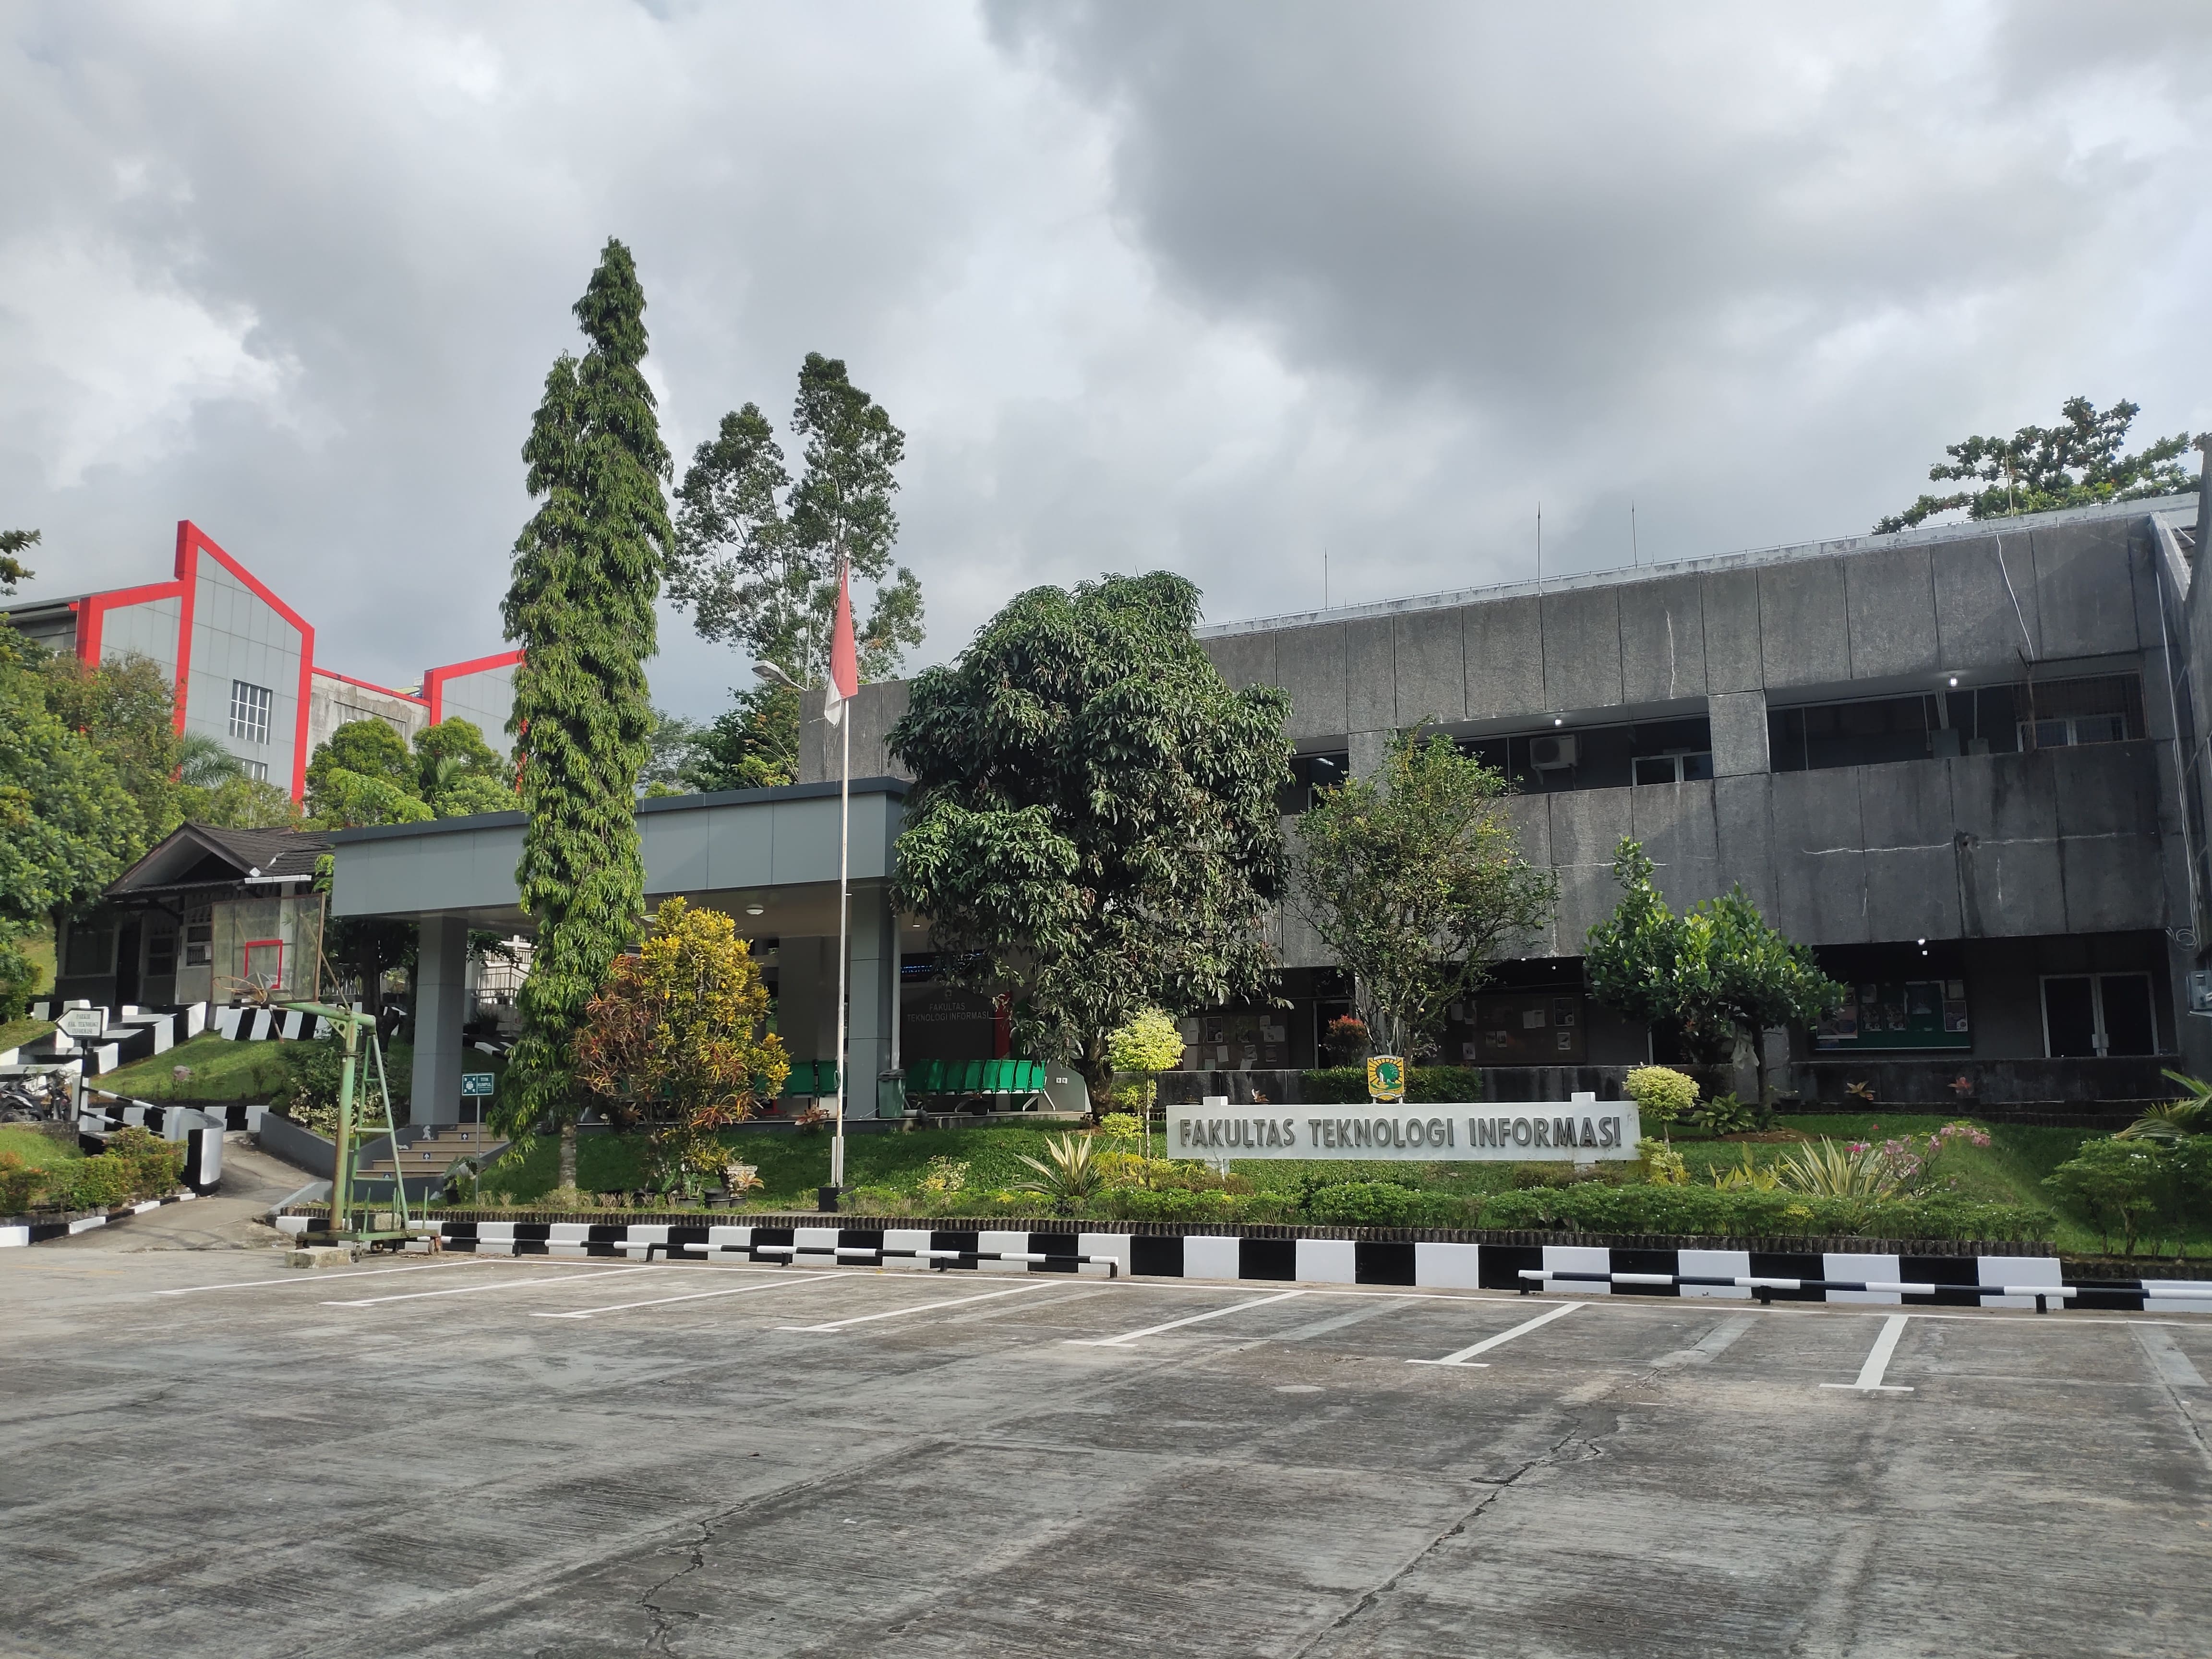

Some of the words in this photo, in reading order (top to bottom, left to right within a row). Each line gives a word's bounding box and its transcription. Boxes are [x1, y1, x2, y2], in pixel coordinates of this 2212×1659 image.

[930, 1002, 965, 1010] FAKULTAS
[907, 1013, 948, 1022] TEKNOLOGI
[950, 1011, 989, 1021] INFORMASI
[1179, 1118, 1296, 1146] FAKULTAS
[1308, 1118, 1454, 1146] TEKNOLOGI
[1468, 1117, 1622, 1146] INFORMASI
